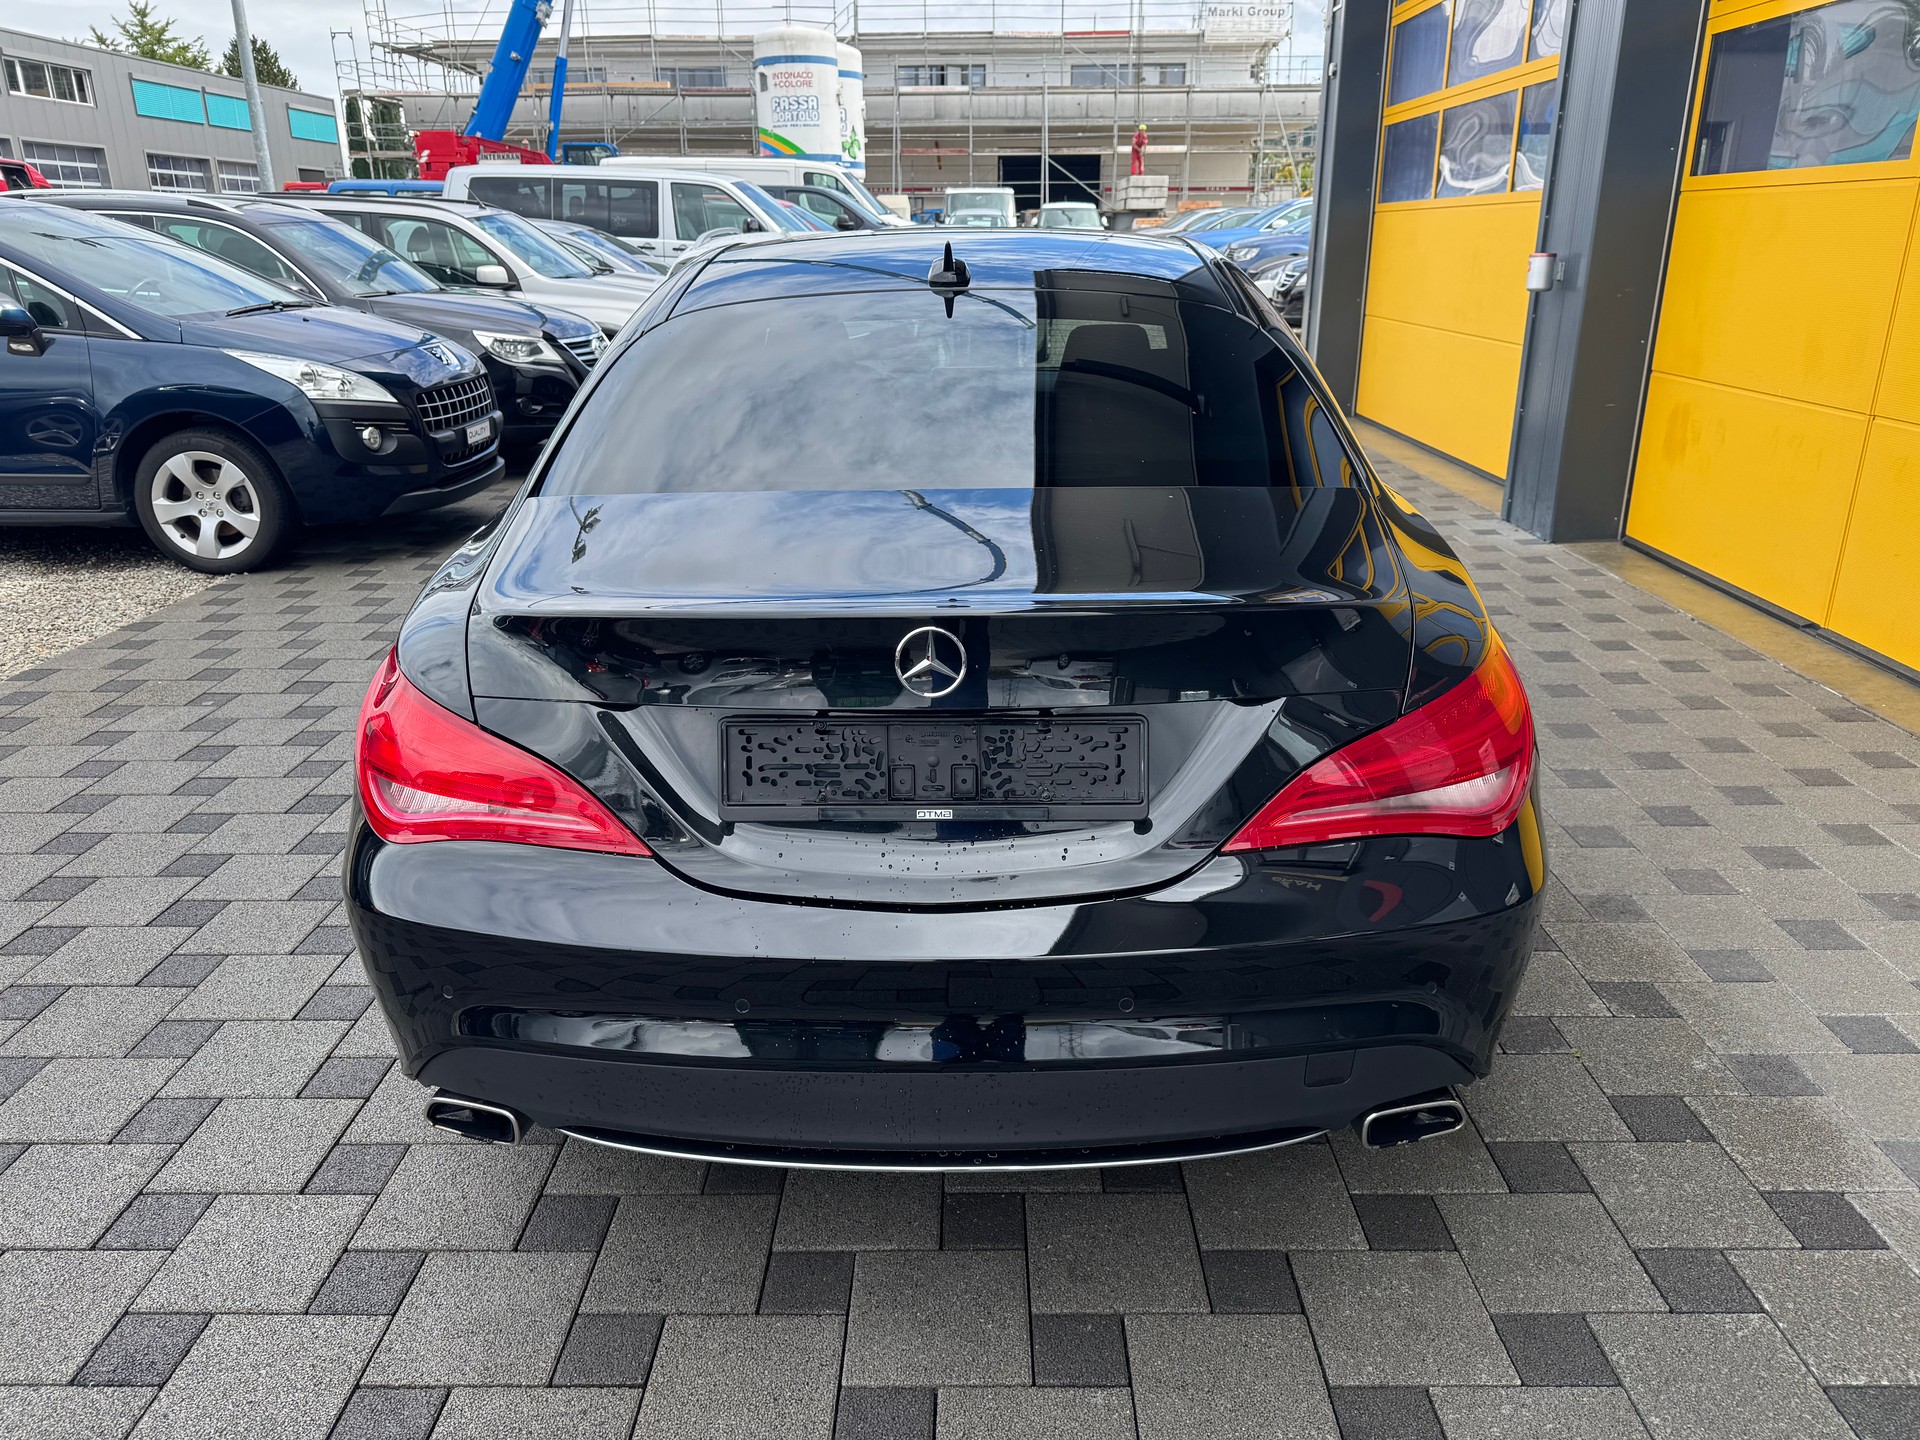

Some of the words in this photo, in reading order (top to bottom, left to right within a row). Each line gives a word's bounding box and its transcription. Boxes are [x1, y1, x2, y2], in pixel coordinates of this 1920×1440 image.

[1207, 6, 1243, 17] Marki
[1247, 6, 1285, 18] Group
[772, 71, 813, 80] INTONACO
[773, 80, 813, 88] +COLORE
[771, 95, 819, 111] FASSA
[772, 110, 820, 123] BORTOLO
[481, 153, 520, 161] INTERKRAN
